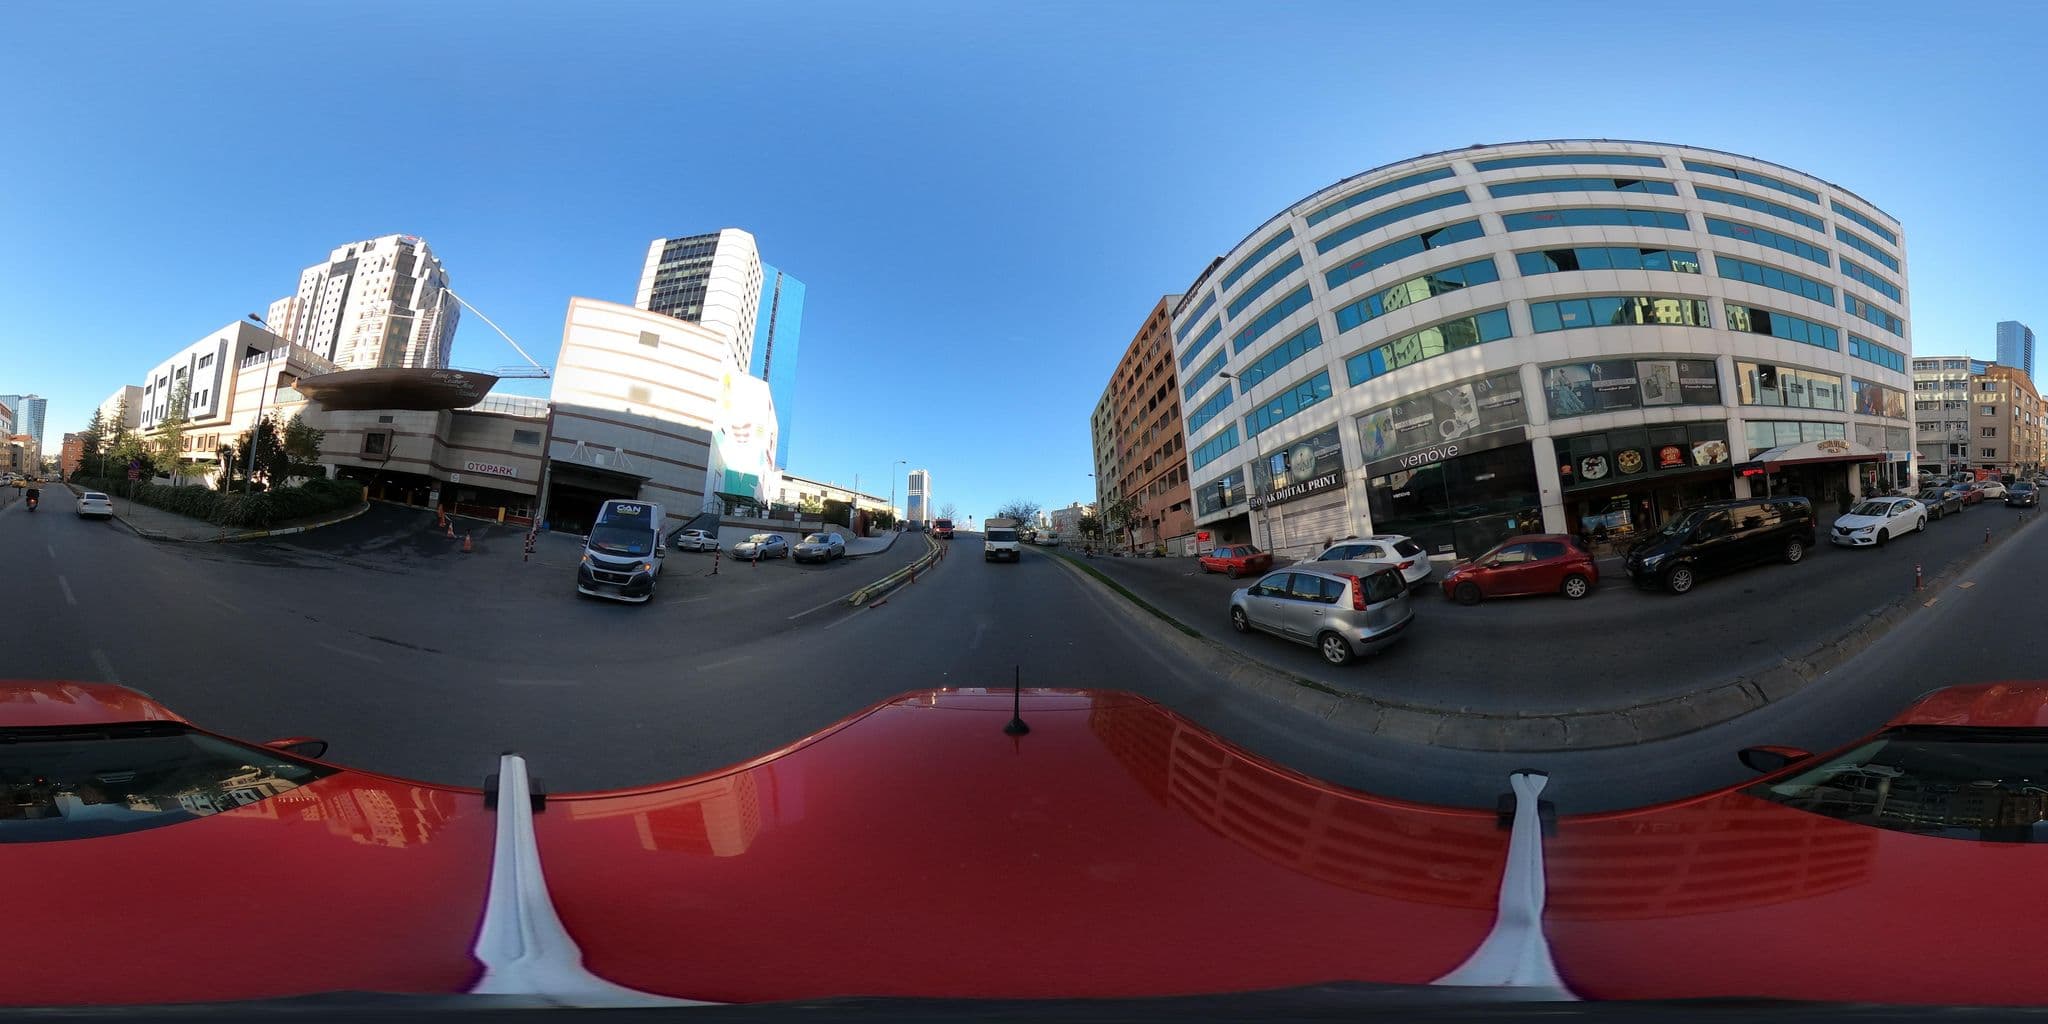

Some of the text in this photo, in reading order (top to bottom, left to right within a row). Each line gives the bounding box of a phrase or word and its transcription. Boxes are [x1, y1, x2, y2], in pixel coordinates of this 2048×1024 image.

[1400, 445, 1458, 468] venöve
[467, 462, 513, 476] OTOPARK
[1308, 473, 1337, 491] PRINT
[616, 504, 642, 512] CAN
